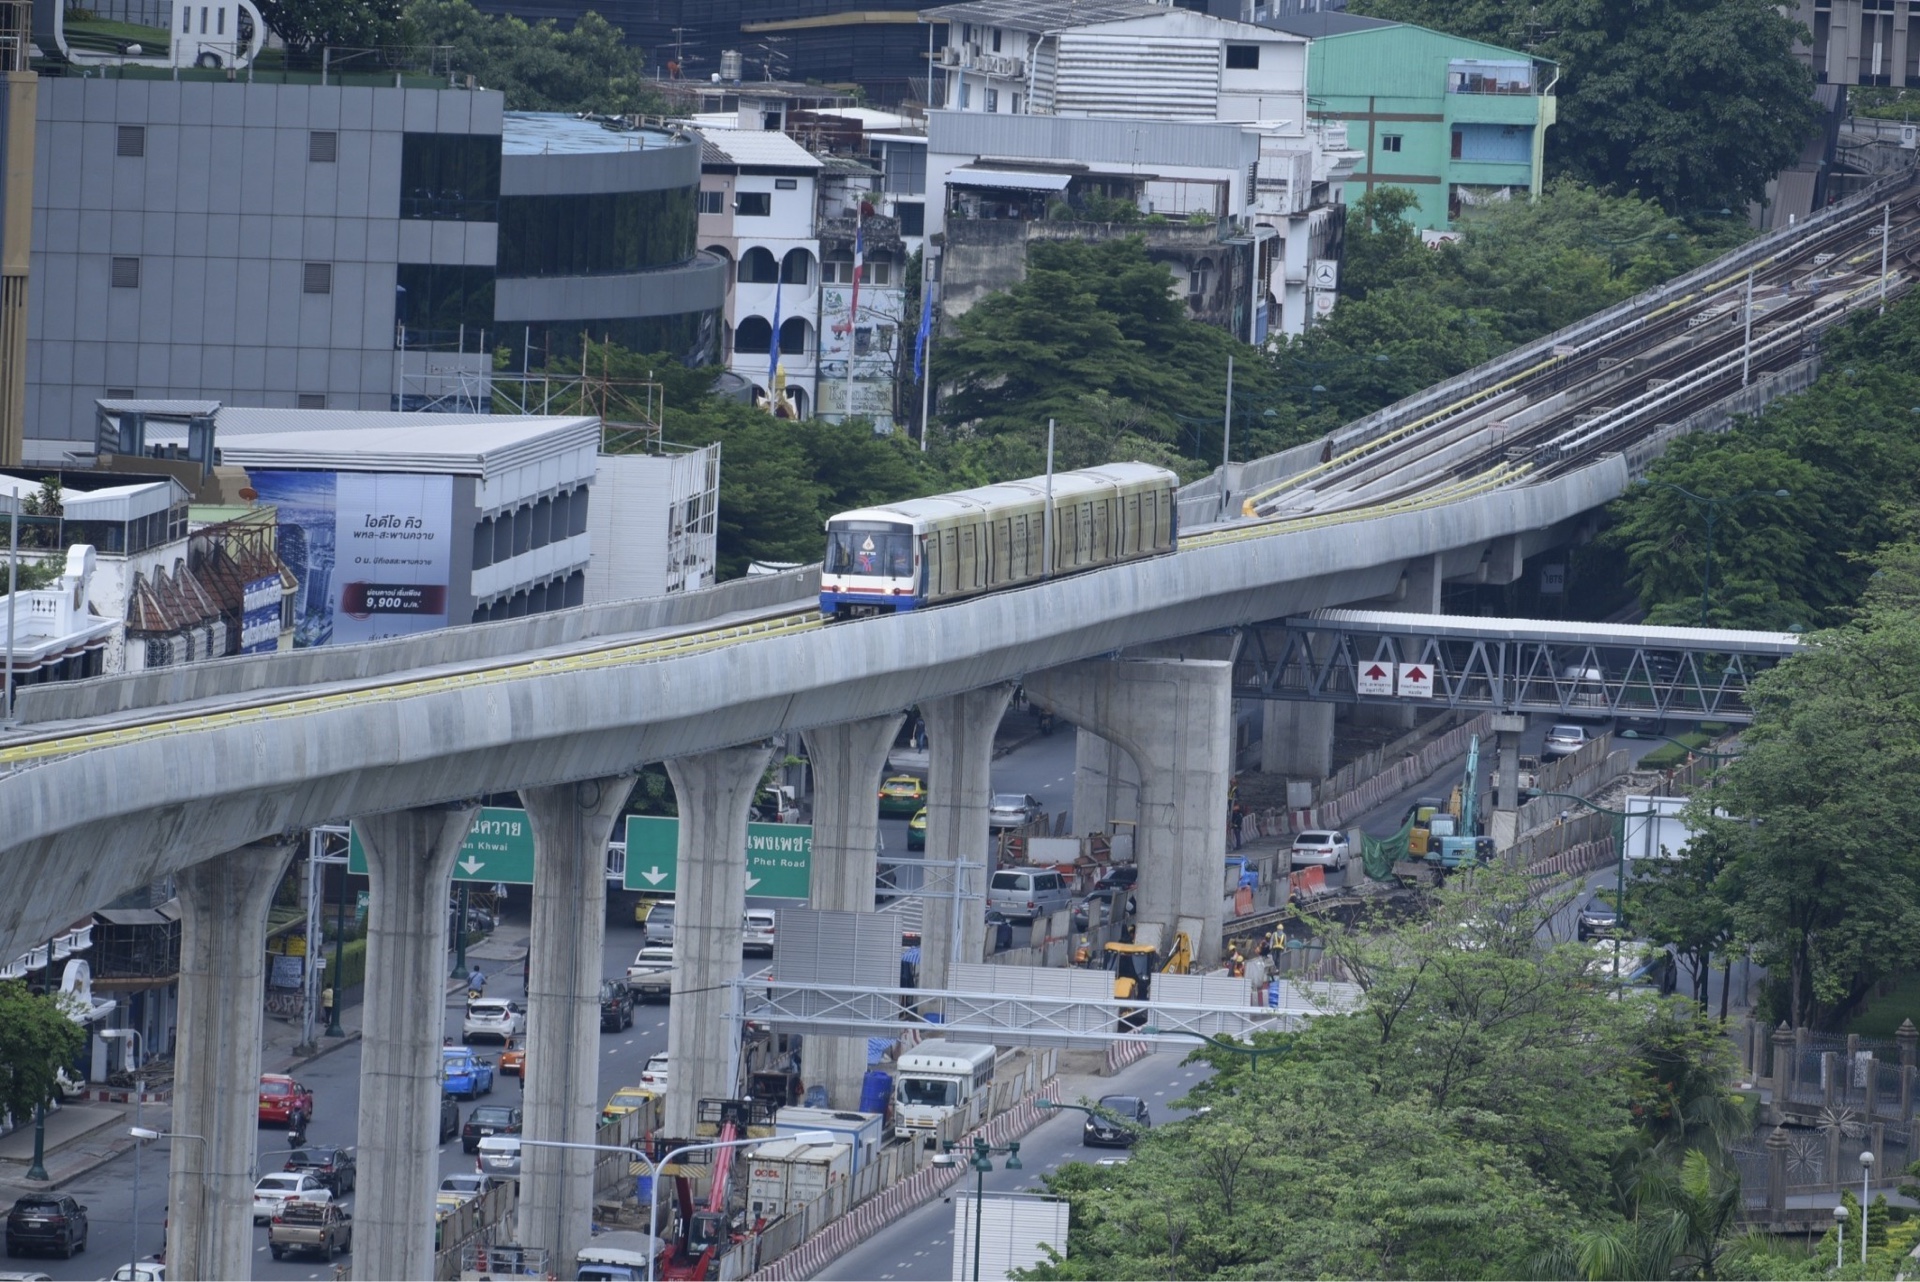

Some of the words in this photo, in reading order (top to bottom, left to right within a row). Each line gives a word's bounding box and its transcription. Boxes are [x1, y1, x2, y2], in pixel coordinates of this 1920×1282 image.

[365, 514, 401, 528] ไอดีโอ
[404, 516, 422, 528] คิว
[366, 598, 401, 610] 9,900
[478, 842, 508, 851] Khwai
[754, 858, 776, 866] Phet
[781, 859, 805, 867] Road
